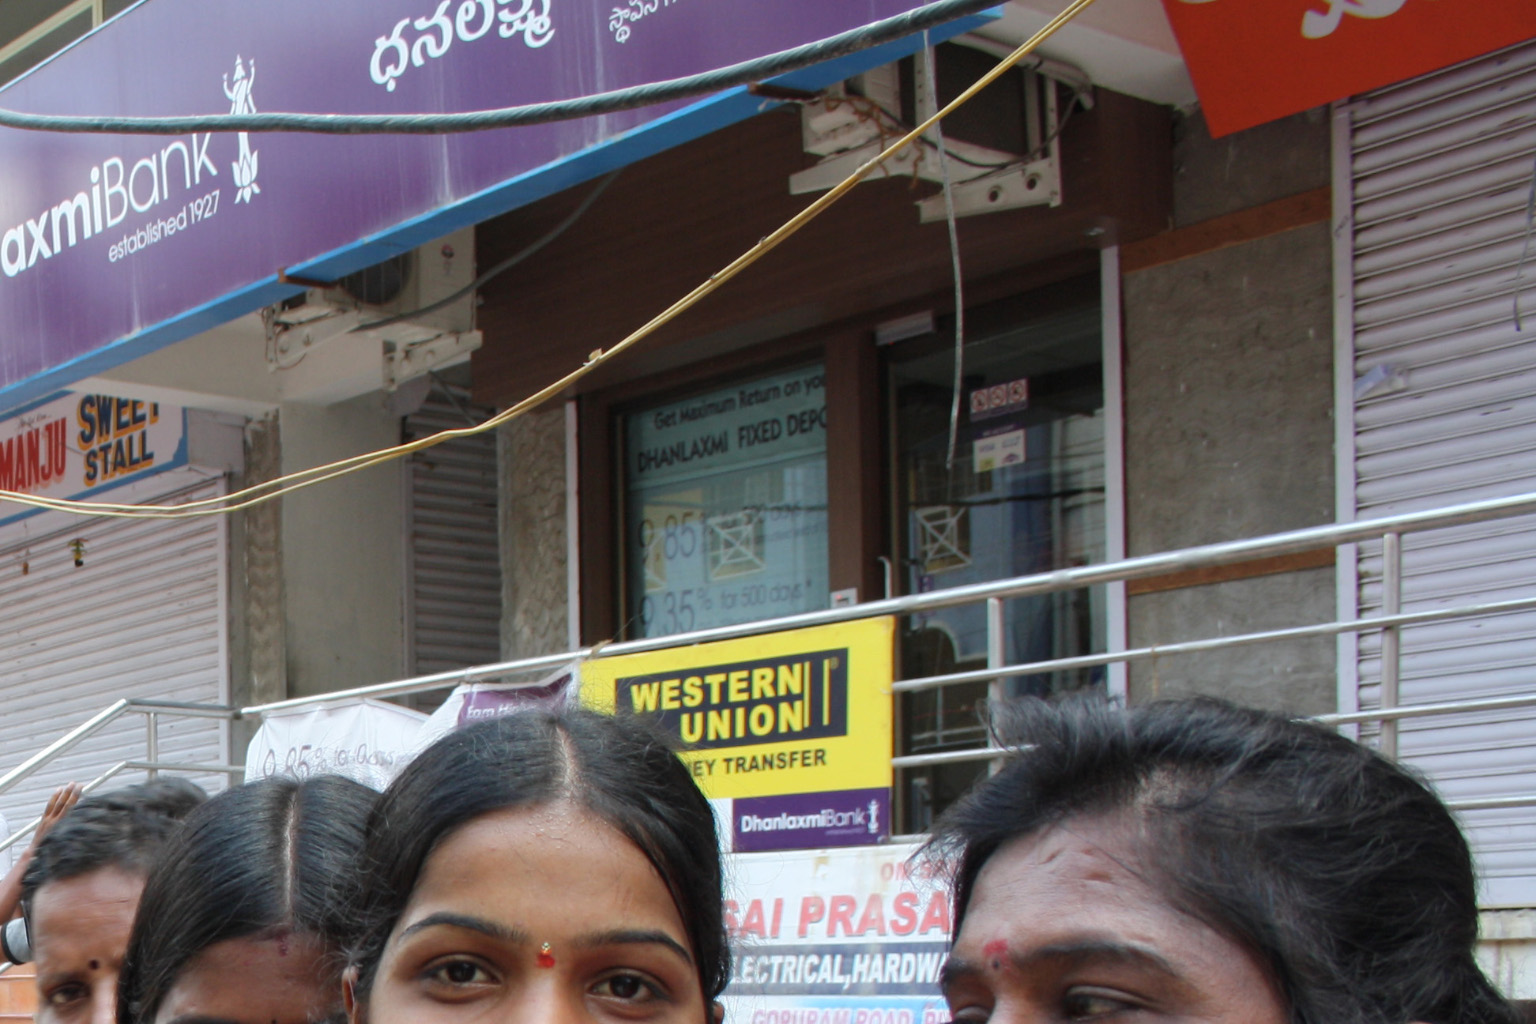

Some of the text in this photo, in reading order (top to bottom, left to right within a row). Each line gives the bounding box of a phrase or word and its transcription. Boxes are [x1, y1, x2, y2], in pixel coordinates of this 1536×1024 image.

[109, 190, 221, 263] established 1927
[680, 396, 737, 421] Maximum
[739, 381, 781, 408] Return
[783, 379, 801, 394] on
[85, 429, 155, 482] STALL
[638, 430, 729, 472] DHANLAXMI
[738, 417, 783, 448] FIXED
[630, 662, 804, 713] WESTERN
[680, 700, 804, 743] UNION
[723, 749, 827, 775] TRANSFER
